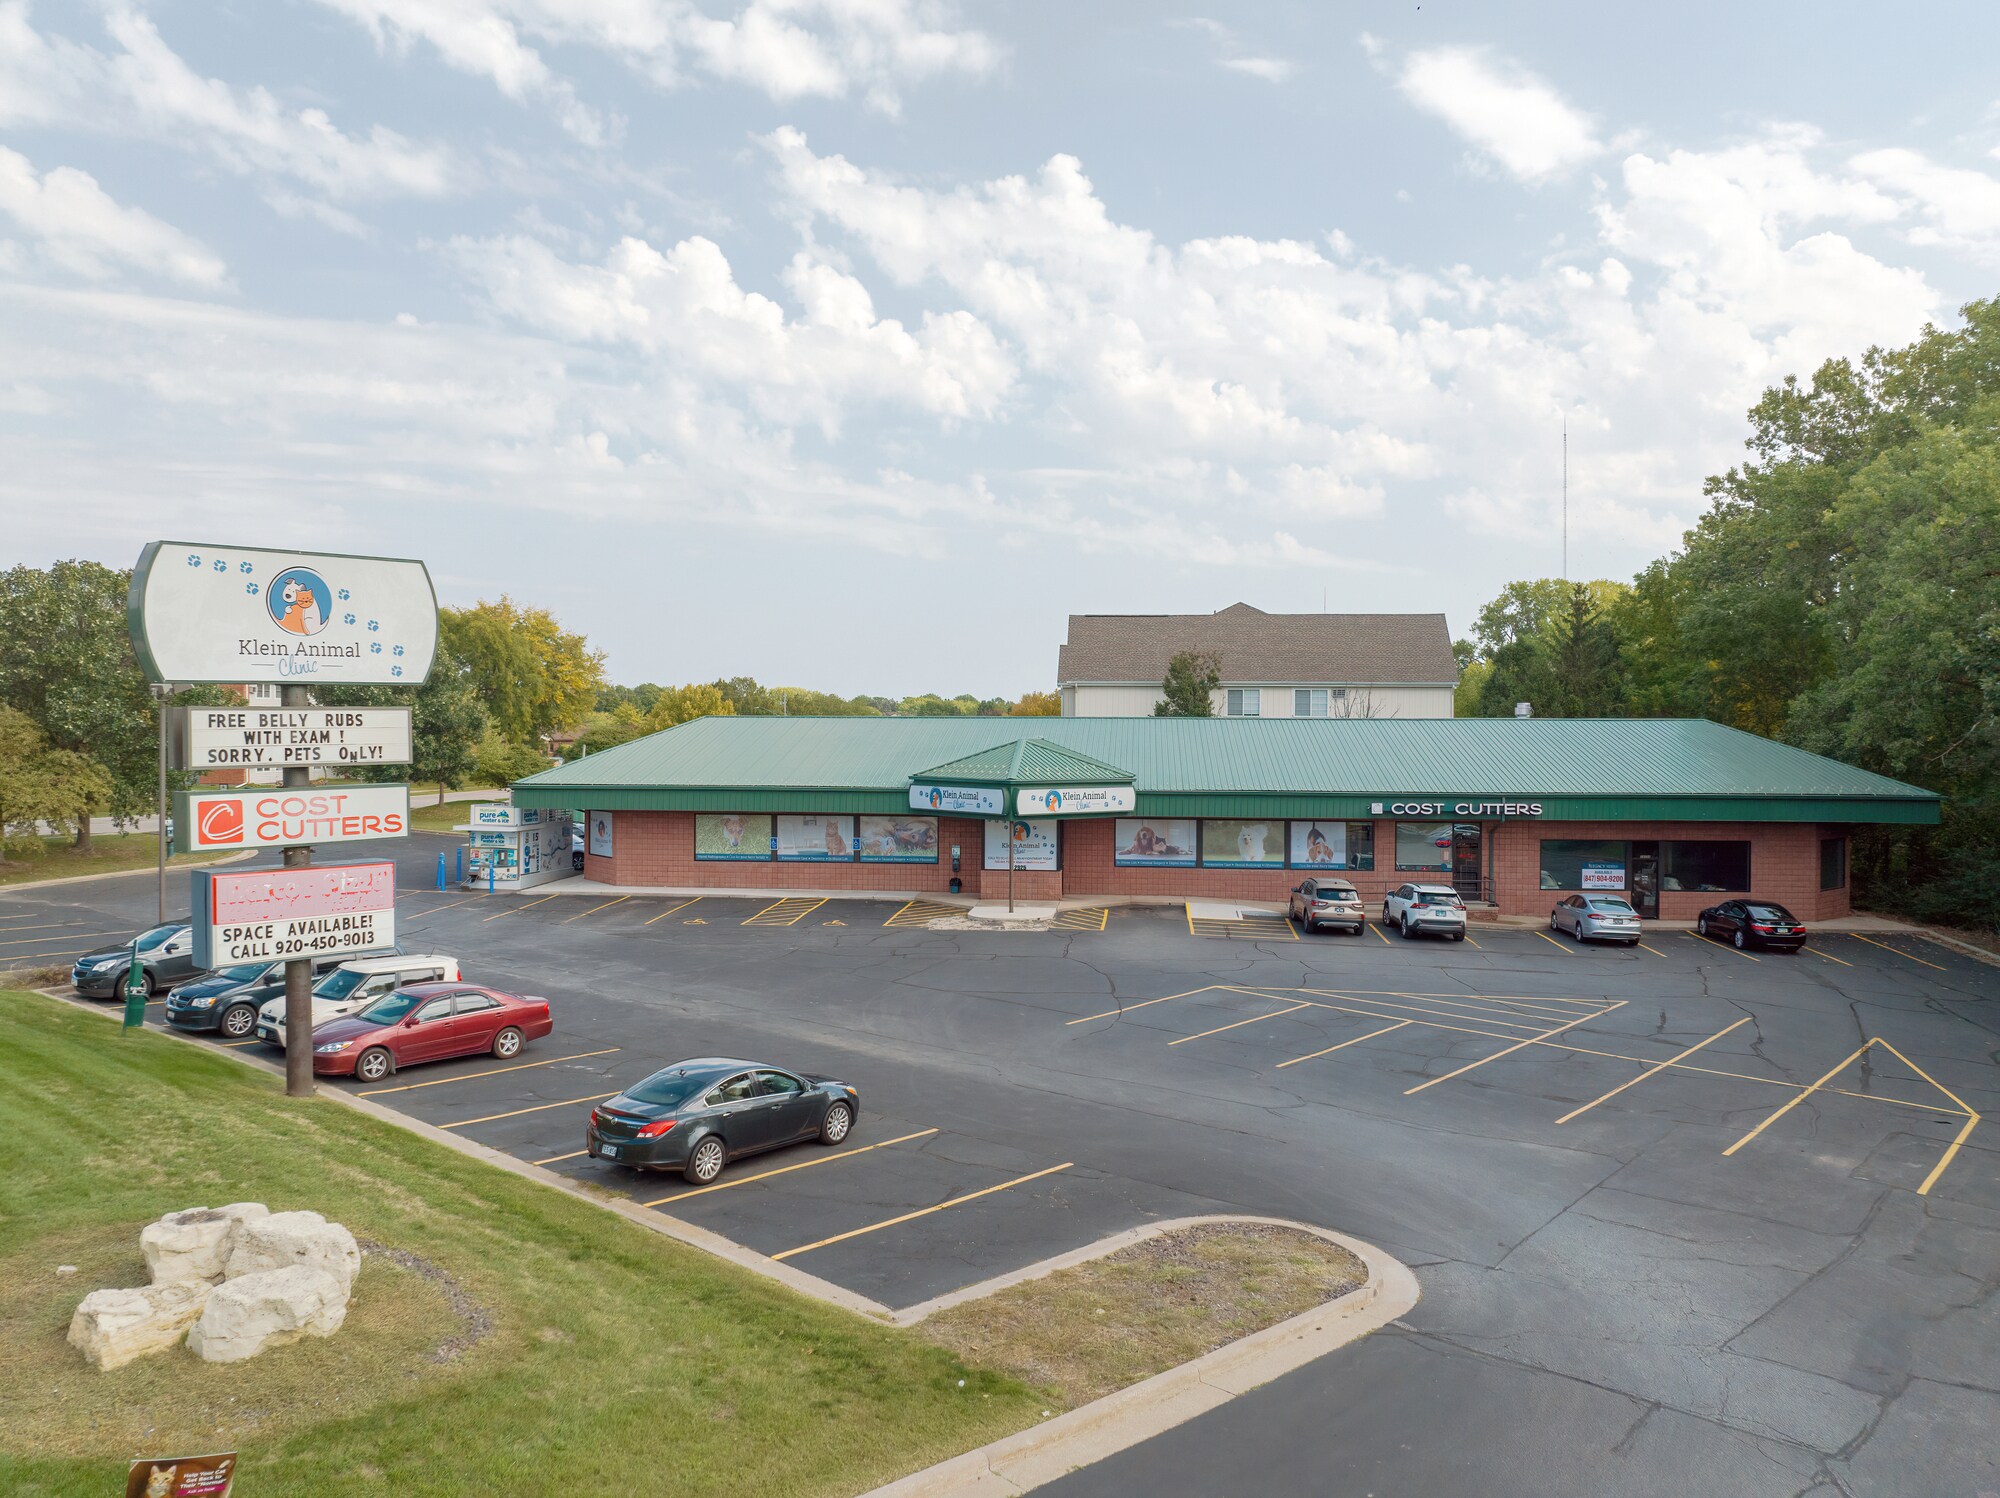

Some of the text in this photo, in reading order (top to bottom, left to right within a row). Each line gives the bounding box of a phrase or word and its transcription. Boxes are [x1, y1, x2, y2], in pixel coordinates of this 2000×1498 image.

[238, 639, 361, 658] Klein Animal
[278, 654, 319, 677] Clinic
[208, 713, 364, 728] FREE BELLY RUBS
[244, 731, 282, 745] WITH
[290, 730, 330, 744] EXAM
[284, 747, 321, 761] PETS
[339, 746, 383, 763] ONLY!
[942, 790, 979, 800] Klein Animal
[1062, 791, 1107, 801] Klein Animal
[256, 795, 348, 818] COST
[1076, 799, 1091, 811] Clinic
[1391, 803, 1543, 815] COST CUTTERS
[480, 812, 496, 820] pure
[256, 814, 403, 841] CUTTERS
[223, 915, 373, 943] SPACE AVAILABLE!
[231, 931, 375, 959] CALL 920-450-9013
